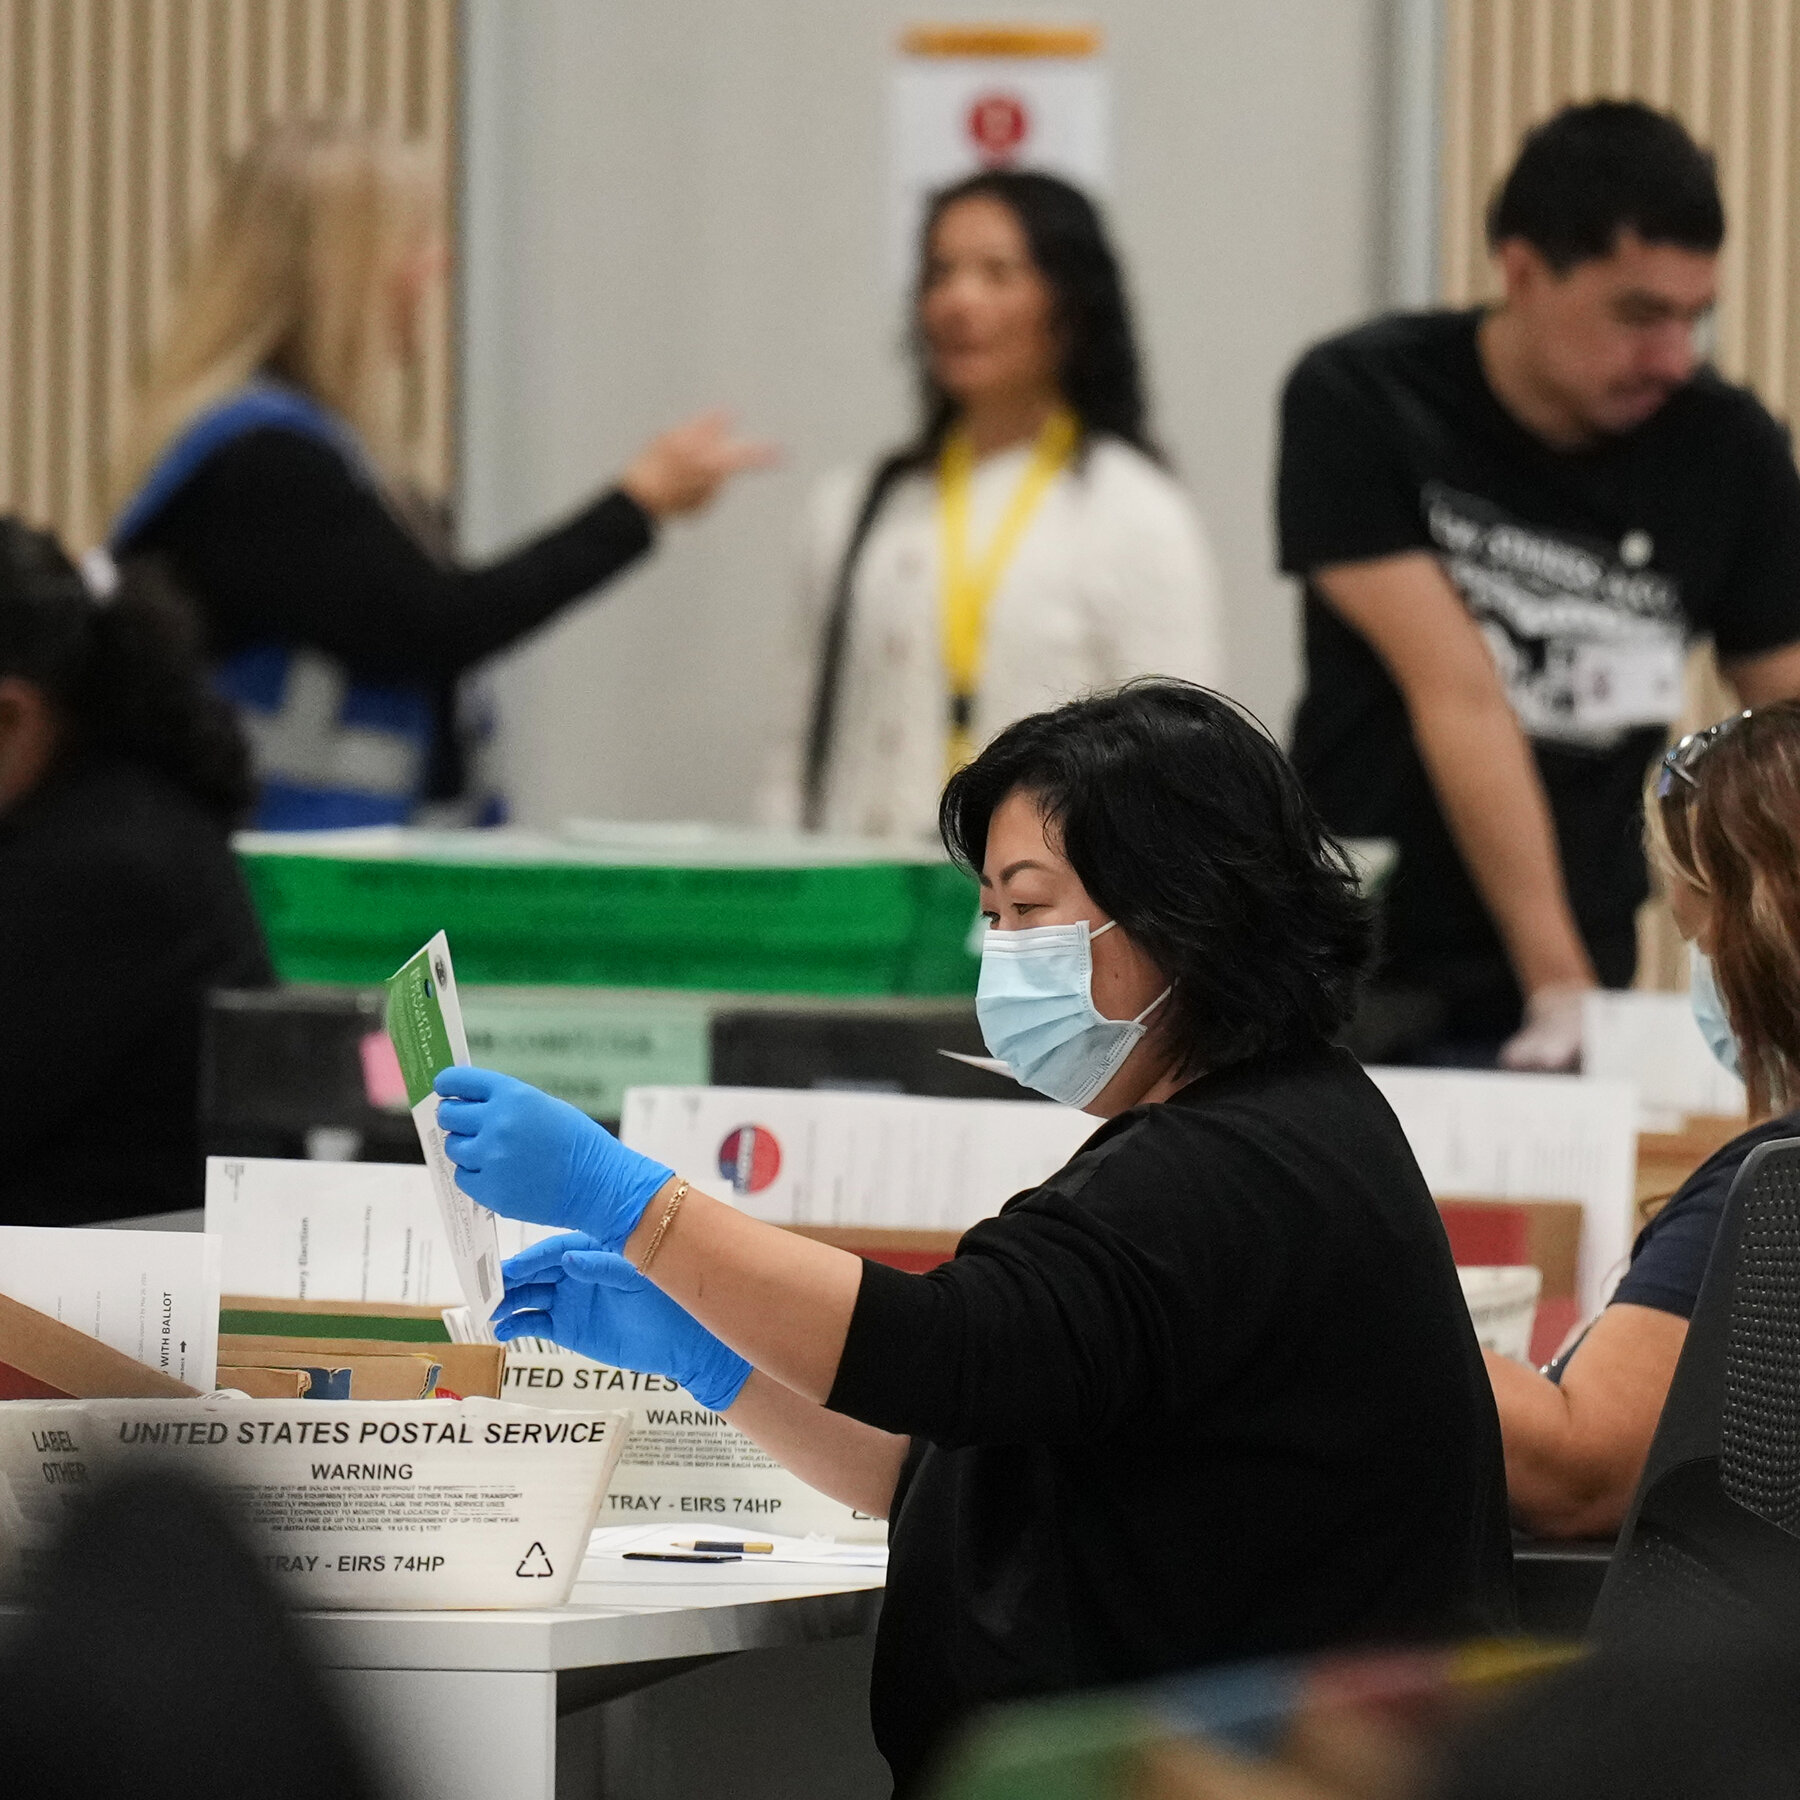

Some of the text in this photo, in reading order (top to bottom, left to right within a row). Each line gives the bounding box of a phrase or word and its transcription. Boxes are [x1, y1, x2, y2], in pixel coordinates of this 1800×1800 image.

[161, 1292, 172, 1334] BALLOT
[160, 1338, 170, 1367] WITH
[503, 1366, 679, 1392] ITED STATES
[646, 1410, 728, 1426] WARNIN
[32, 1430, 78, 1453] LABEL
[119, 1421, 606, 1445] UNITED STATES POSTAL SERVICE
[311, 1464, 413, 1480] WARNING
[608, 1495, 660, 1512] TRAY
[681, 1496, 726, 1513] EIRS
[734, 1498, 782, 1514] 74HP
[265, 1556, 319, 1572] TRAY
[338, 1556, 385, 1572] EIRS
[393, 1556, 445, 1572] 74HP
